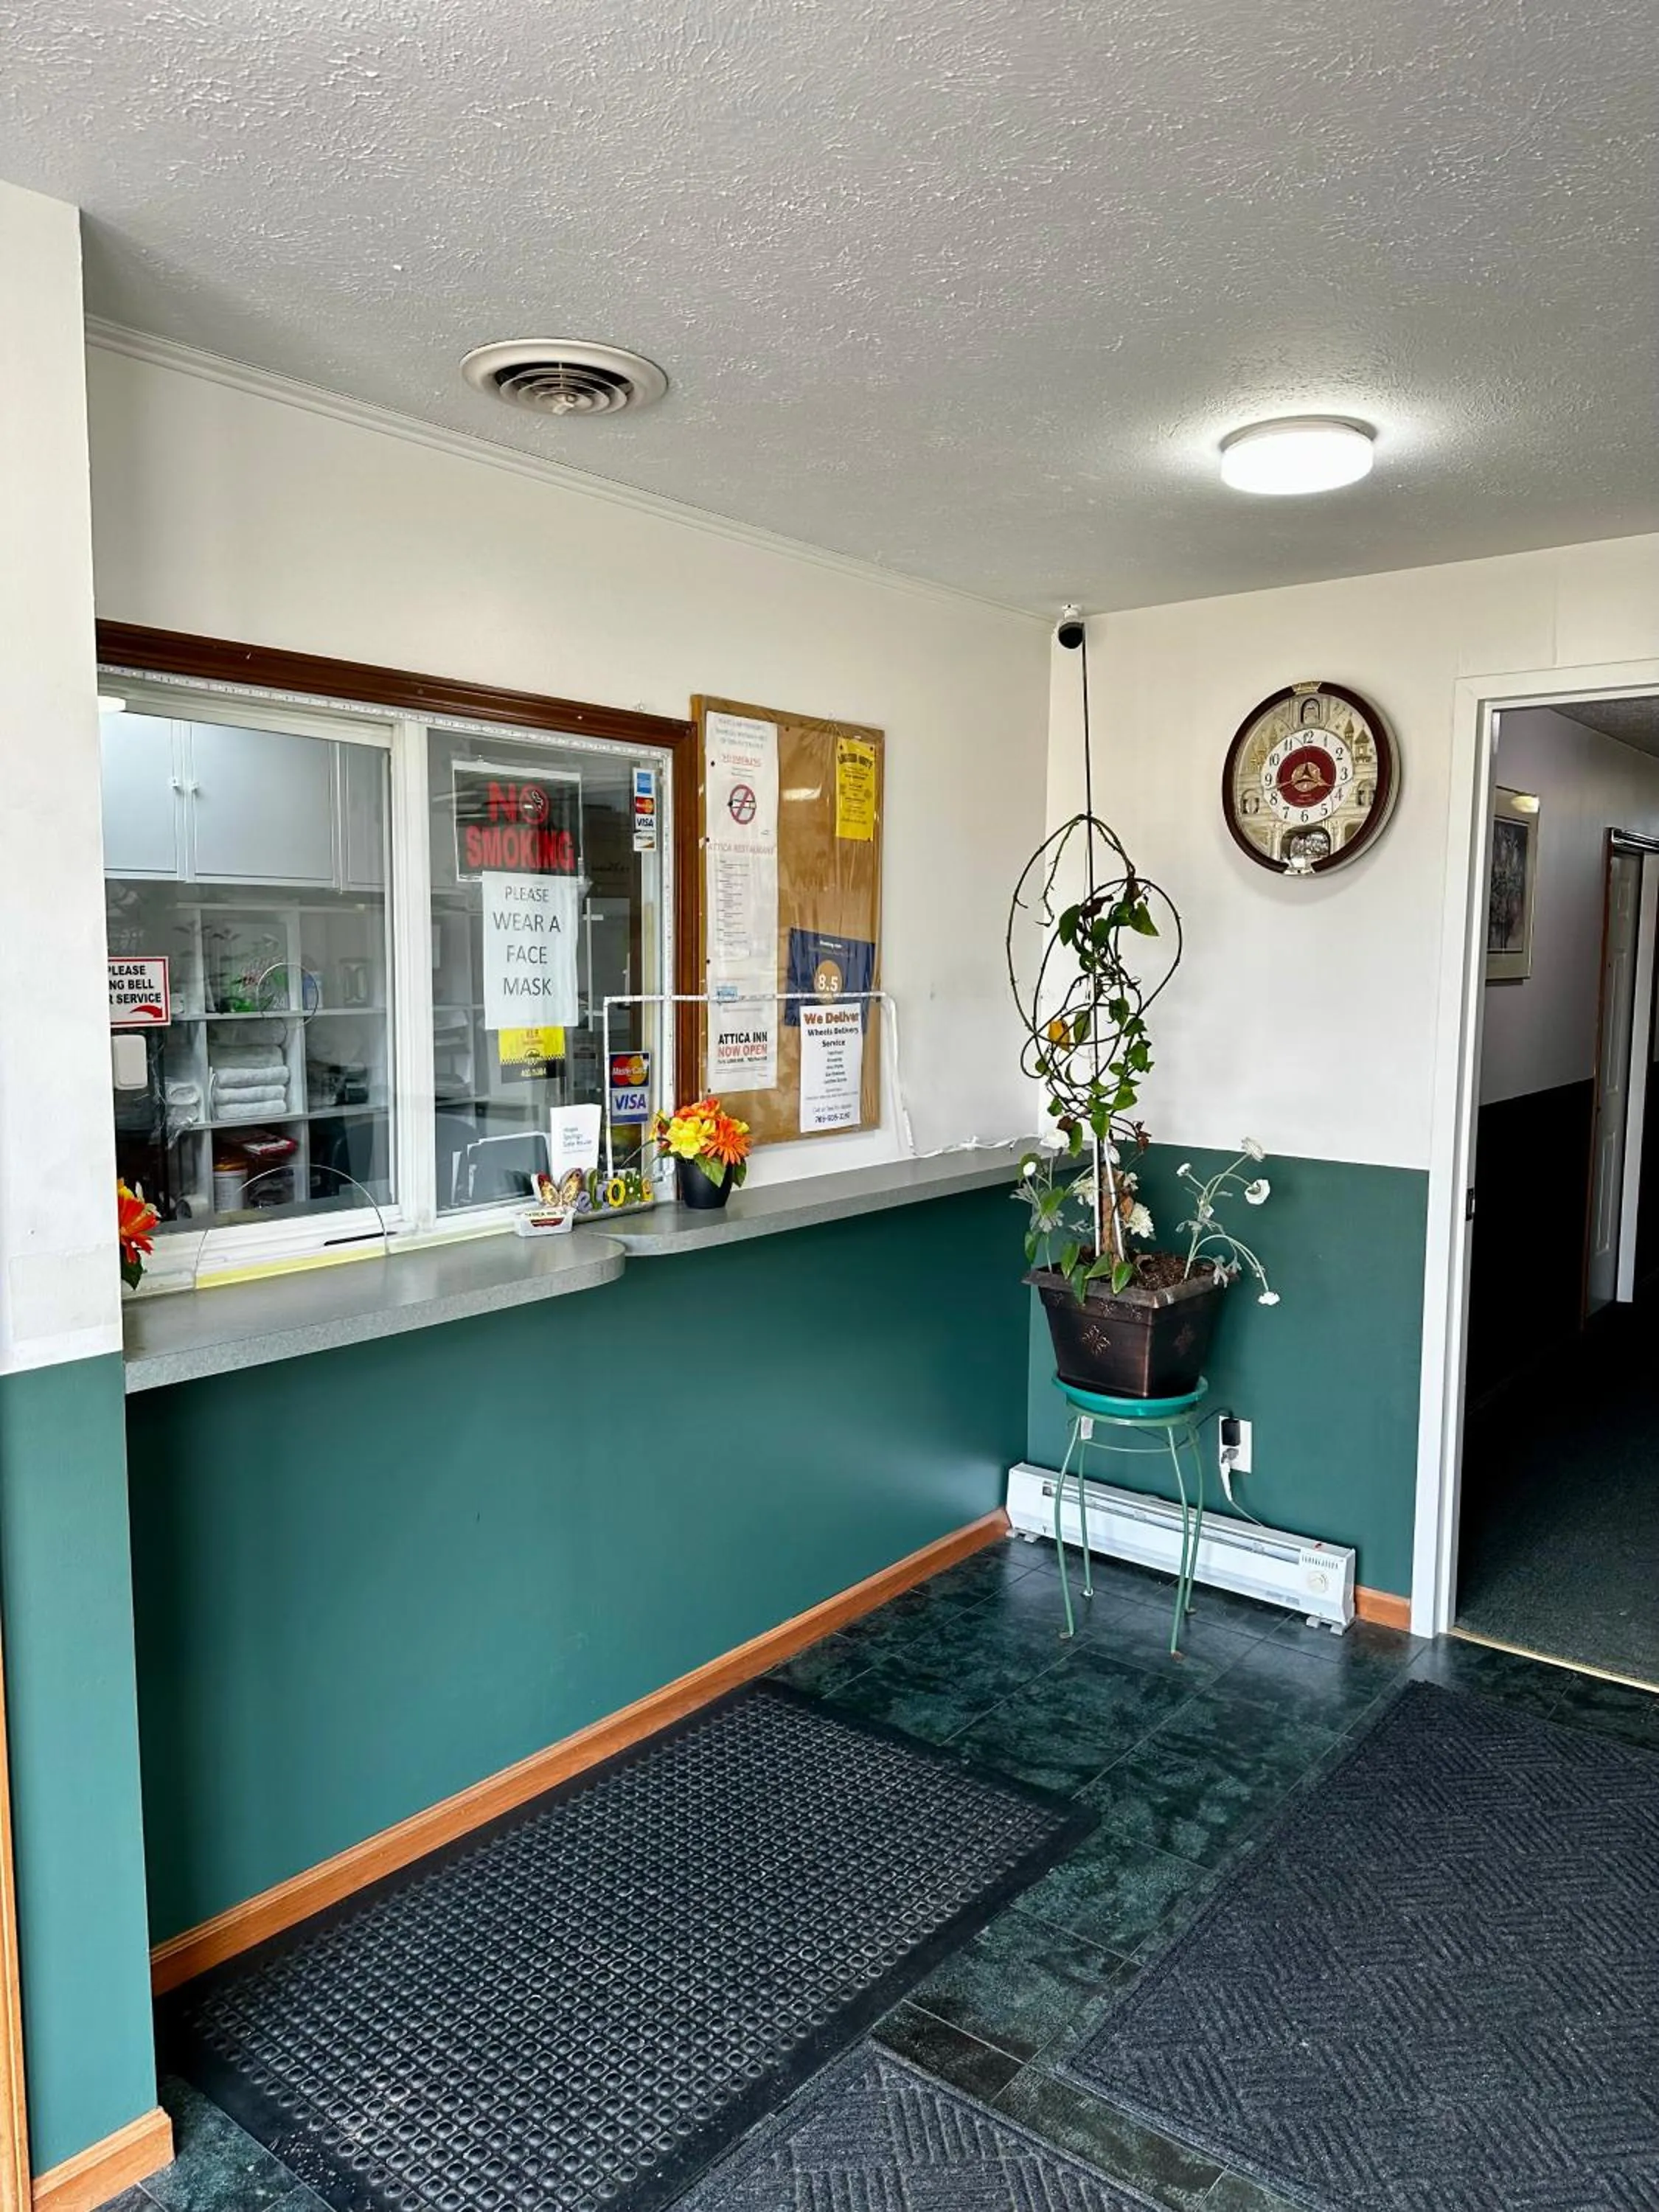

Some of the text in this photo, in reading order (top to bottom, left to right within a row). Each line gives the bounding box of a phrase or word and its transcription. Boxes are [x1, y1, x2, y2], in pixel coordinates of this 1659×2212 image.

[1303, 730, 1314, 744] 12
[1284, 739, 1293, 751] 11
[1269, 754, 1279, 766] 10
[1335, 748, 1343, 761] 2
[1265, 773, 1273, 787] 9
[1340, 768, 1349, 781] 3
[1269, 791, 1278, 806] 8
[1334, 787, 1343, 801] 4
[488, 782, 549, 825] NO
[1320, 804, 1328, 816] 5
[1283, 806, 1290, 819] 7
[1301, 810, 1309, 823] 6
[636, 818, 654, 827] VISA
[465, 825, 575, 872] SMOKING
[505, 886, 549, 902] PLEASE
[493, 911, 561, 933] WEAR A
[507, 945, 548, 964] FACE
[128, 978, 154, 990] BELL
[503, 977, 552, 996] MASK
[818, 974, 838, 992] 8.5
[116, 992, 161, 1004] SERVICE
[804, 1010, 859, 1025] We Deliver
[718, 1032, 768, 1045] ATTICA INN
[822, 1040, 846, 1048] Service
[718, 1043, 768, 1058] NOW OPEN
[615, 1093, 647, 1111] VISA
